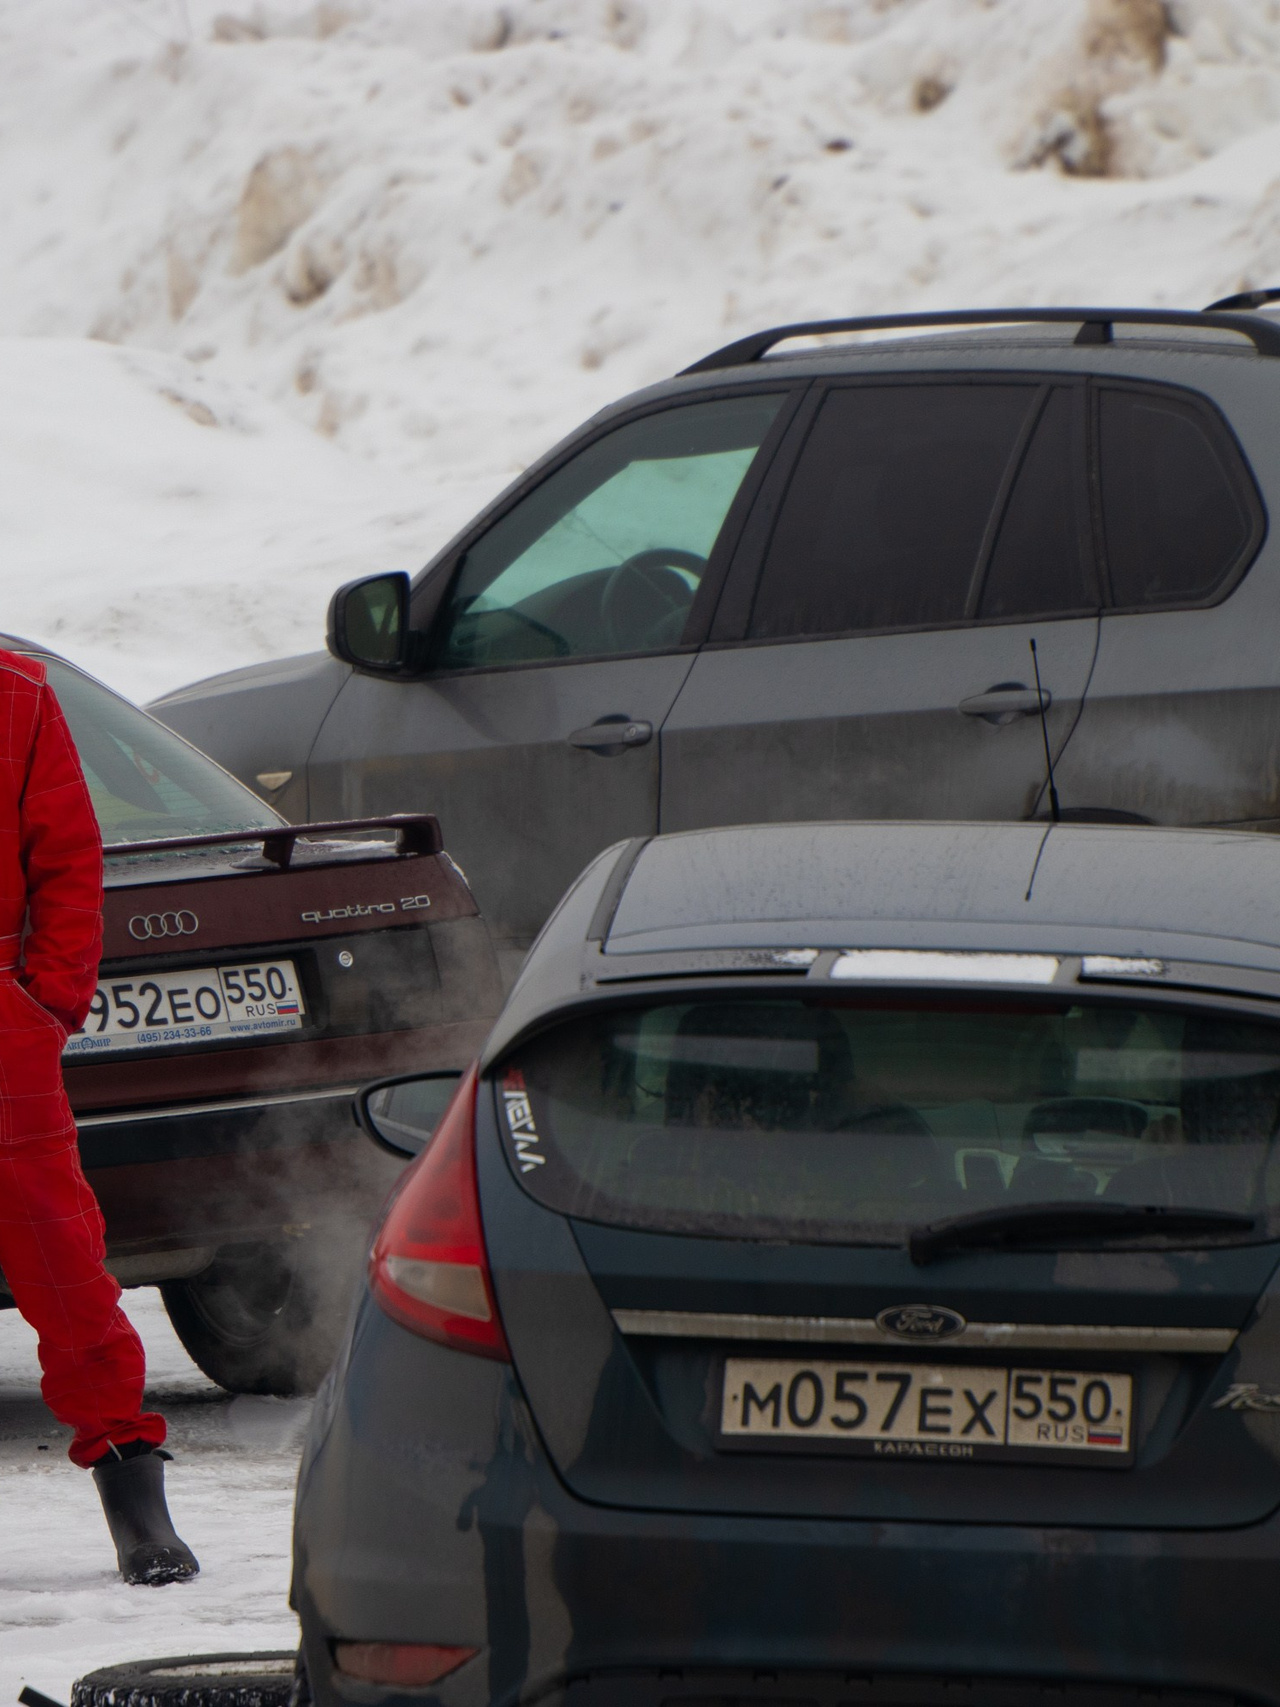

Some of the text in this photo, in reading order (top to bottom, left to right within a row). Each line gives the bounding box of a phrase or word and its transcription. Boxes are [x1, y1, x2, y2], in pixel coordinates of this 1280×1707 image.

[301, 894, 431, 923] quattro 20
[223, 966, 286, 1004] 550
[72, 981, 221, 1033] 952EO
[246, 1003, 276, 1017] RUS
[137, 1026, 212, 1044] (495) 234-33-66
[229, 1018, 296, 1032] www.avtomir.ru
[1012, 1375, 1113, 1424] 550
[1037, 1423, 1085, 1444] RUS
